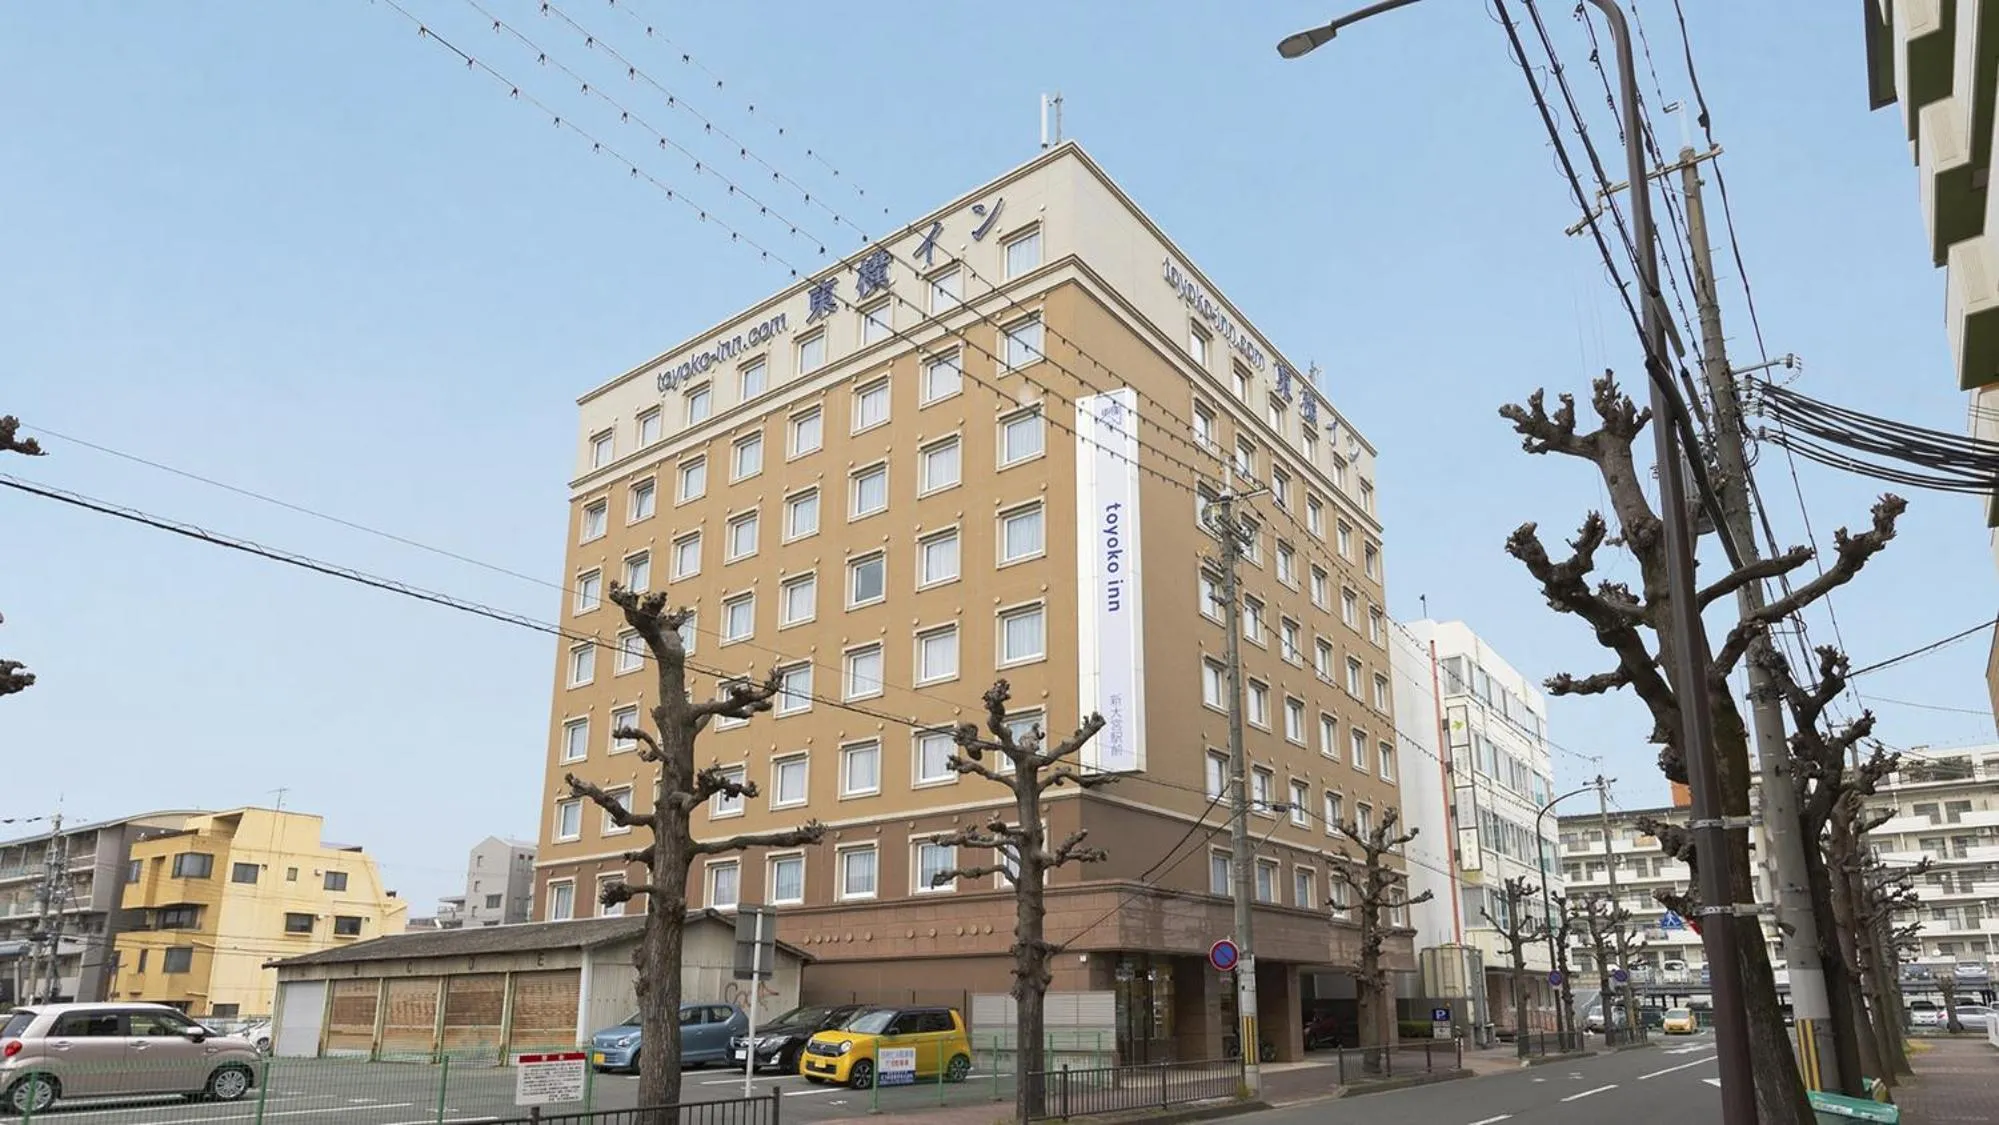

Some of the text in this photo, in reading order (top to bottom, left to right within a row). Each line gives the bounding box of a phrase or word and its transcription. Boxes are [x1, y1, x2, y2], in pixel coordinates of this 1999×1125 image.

[656, 311, 789, 395] toyoko-inn.com
[1162, 256, 1266, 372] toyoko-inn.com
[1103, 502, 1124, 612] toyoko inn
[1435, 1009, 1447, 1020] P
